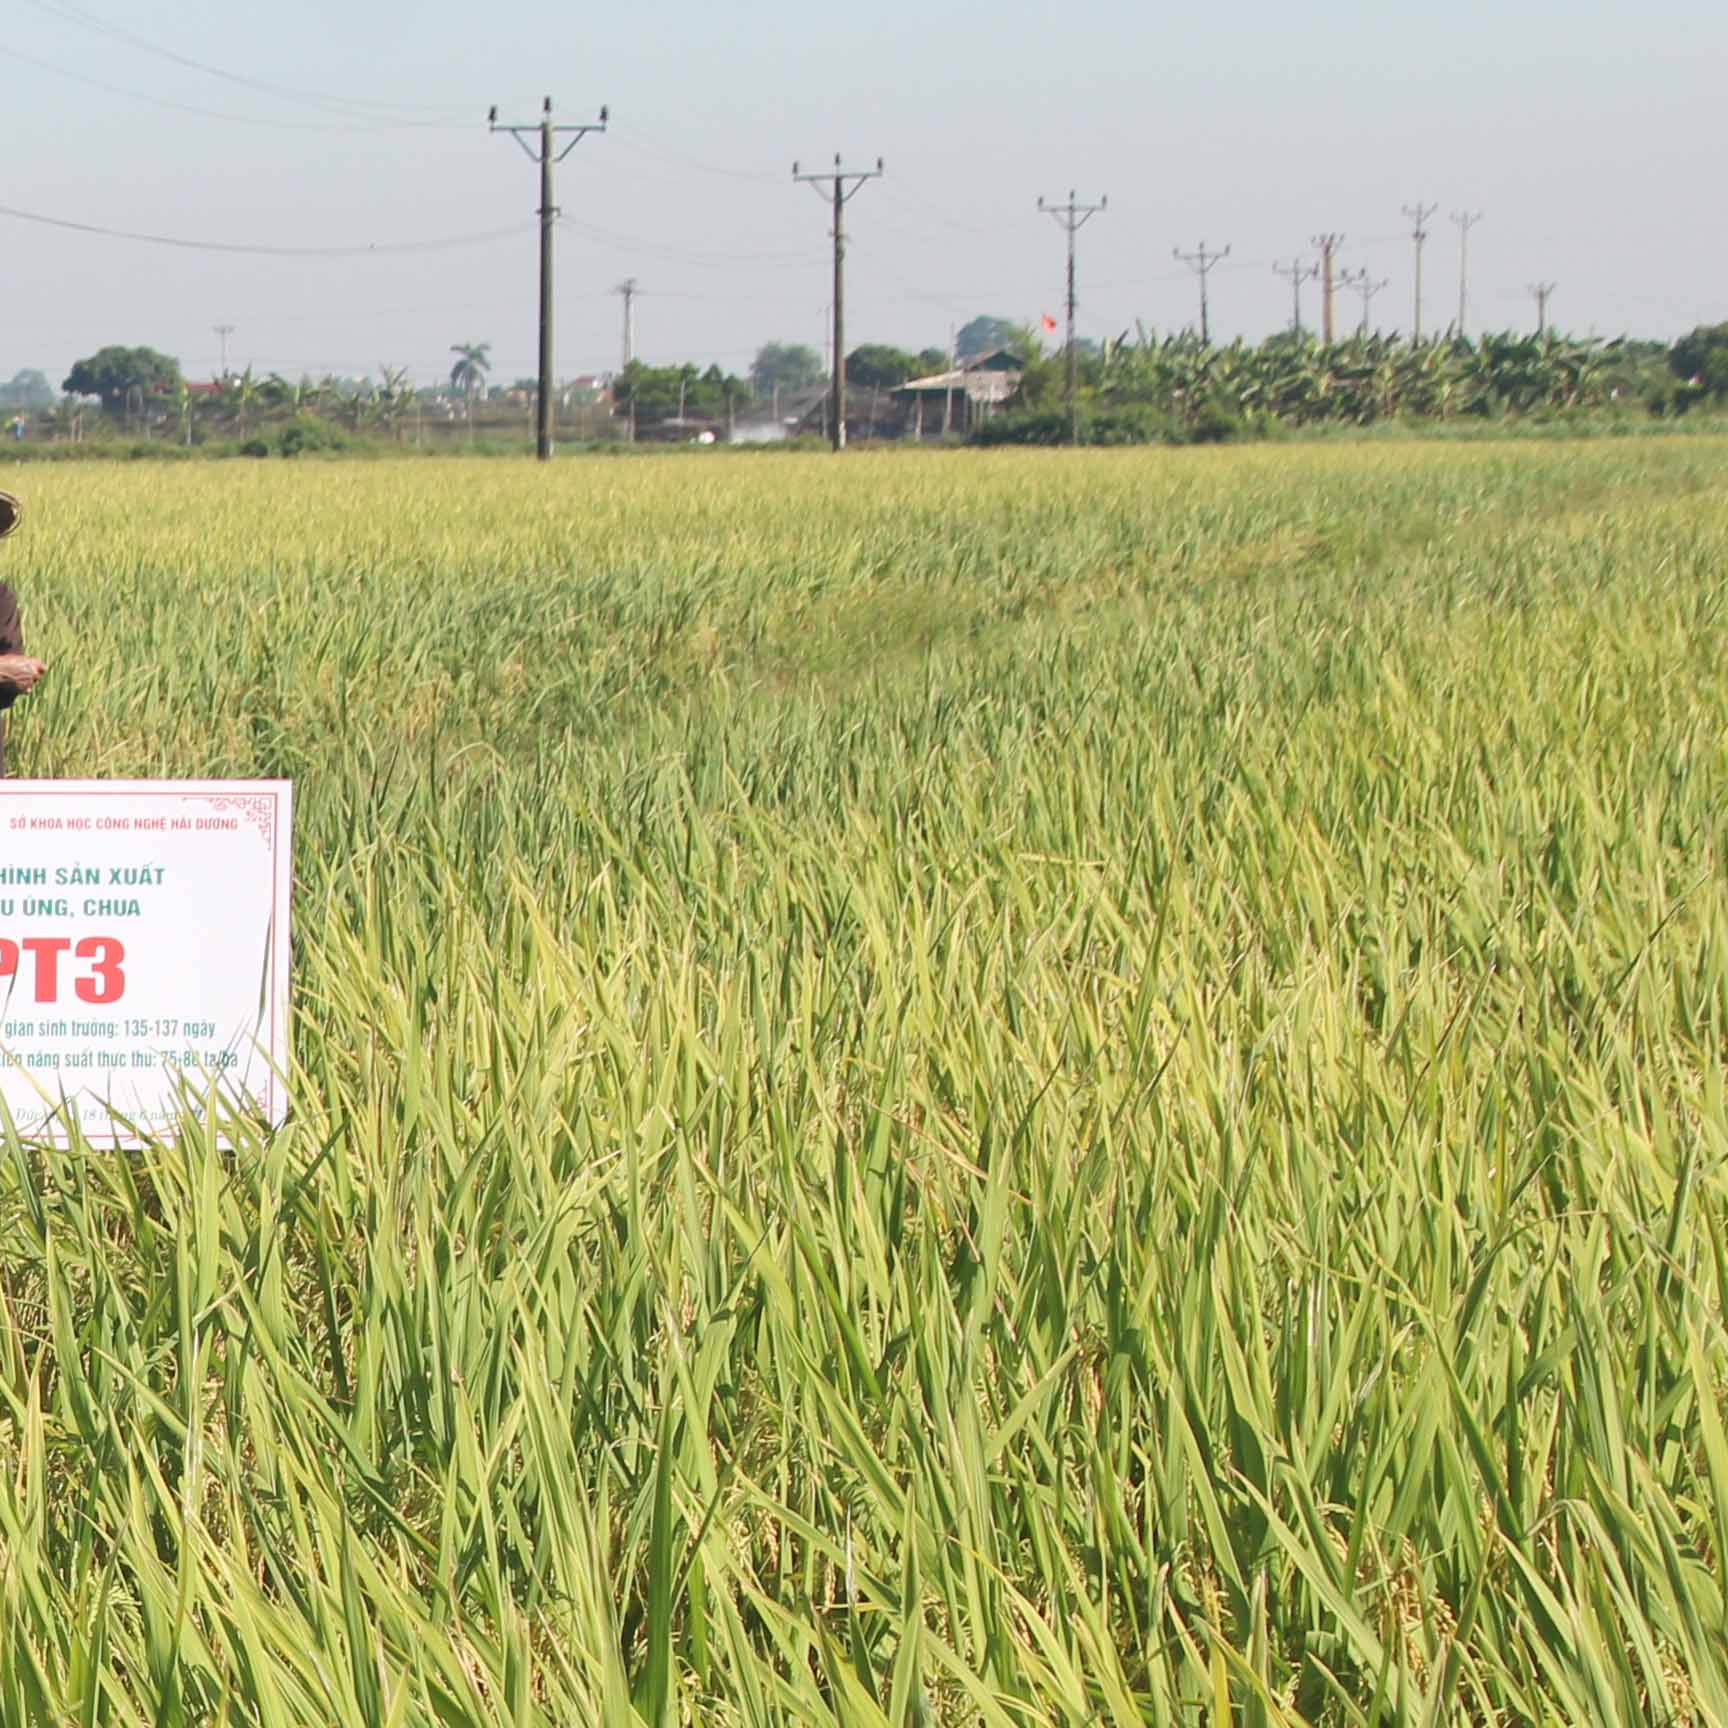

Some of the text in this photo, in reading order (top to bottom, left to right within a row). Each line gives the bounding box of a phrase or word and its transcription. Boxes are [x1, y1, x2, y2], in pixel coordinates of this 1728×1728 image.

[30, 817, 64, 830] KHOA
[67, 817, 91, 832] HỌC
[95, 815, 130, 830] CÔNG
[134, 815, 167, 832] NGHỆ
[195, 816, 238, 830] DƯƠNG
[55, 861, 101, 885] SẢN
[109, 861, 166, 885] XUẤT
[83, 898, 142, 916] CHUA
[4, 1018, 34, 1039] gian
[39, 1018, 67, 1037] sinh
[124, 1019, 178, 1037] 135-137
[182, 1018, 216, 1039] ngày
[27, 1049, 60, 1070] năng
[65, 1046, 93, 1067] suất
[131, 1050, 157, 1067] thu:
